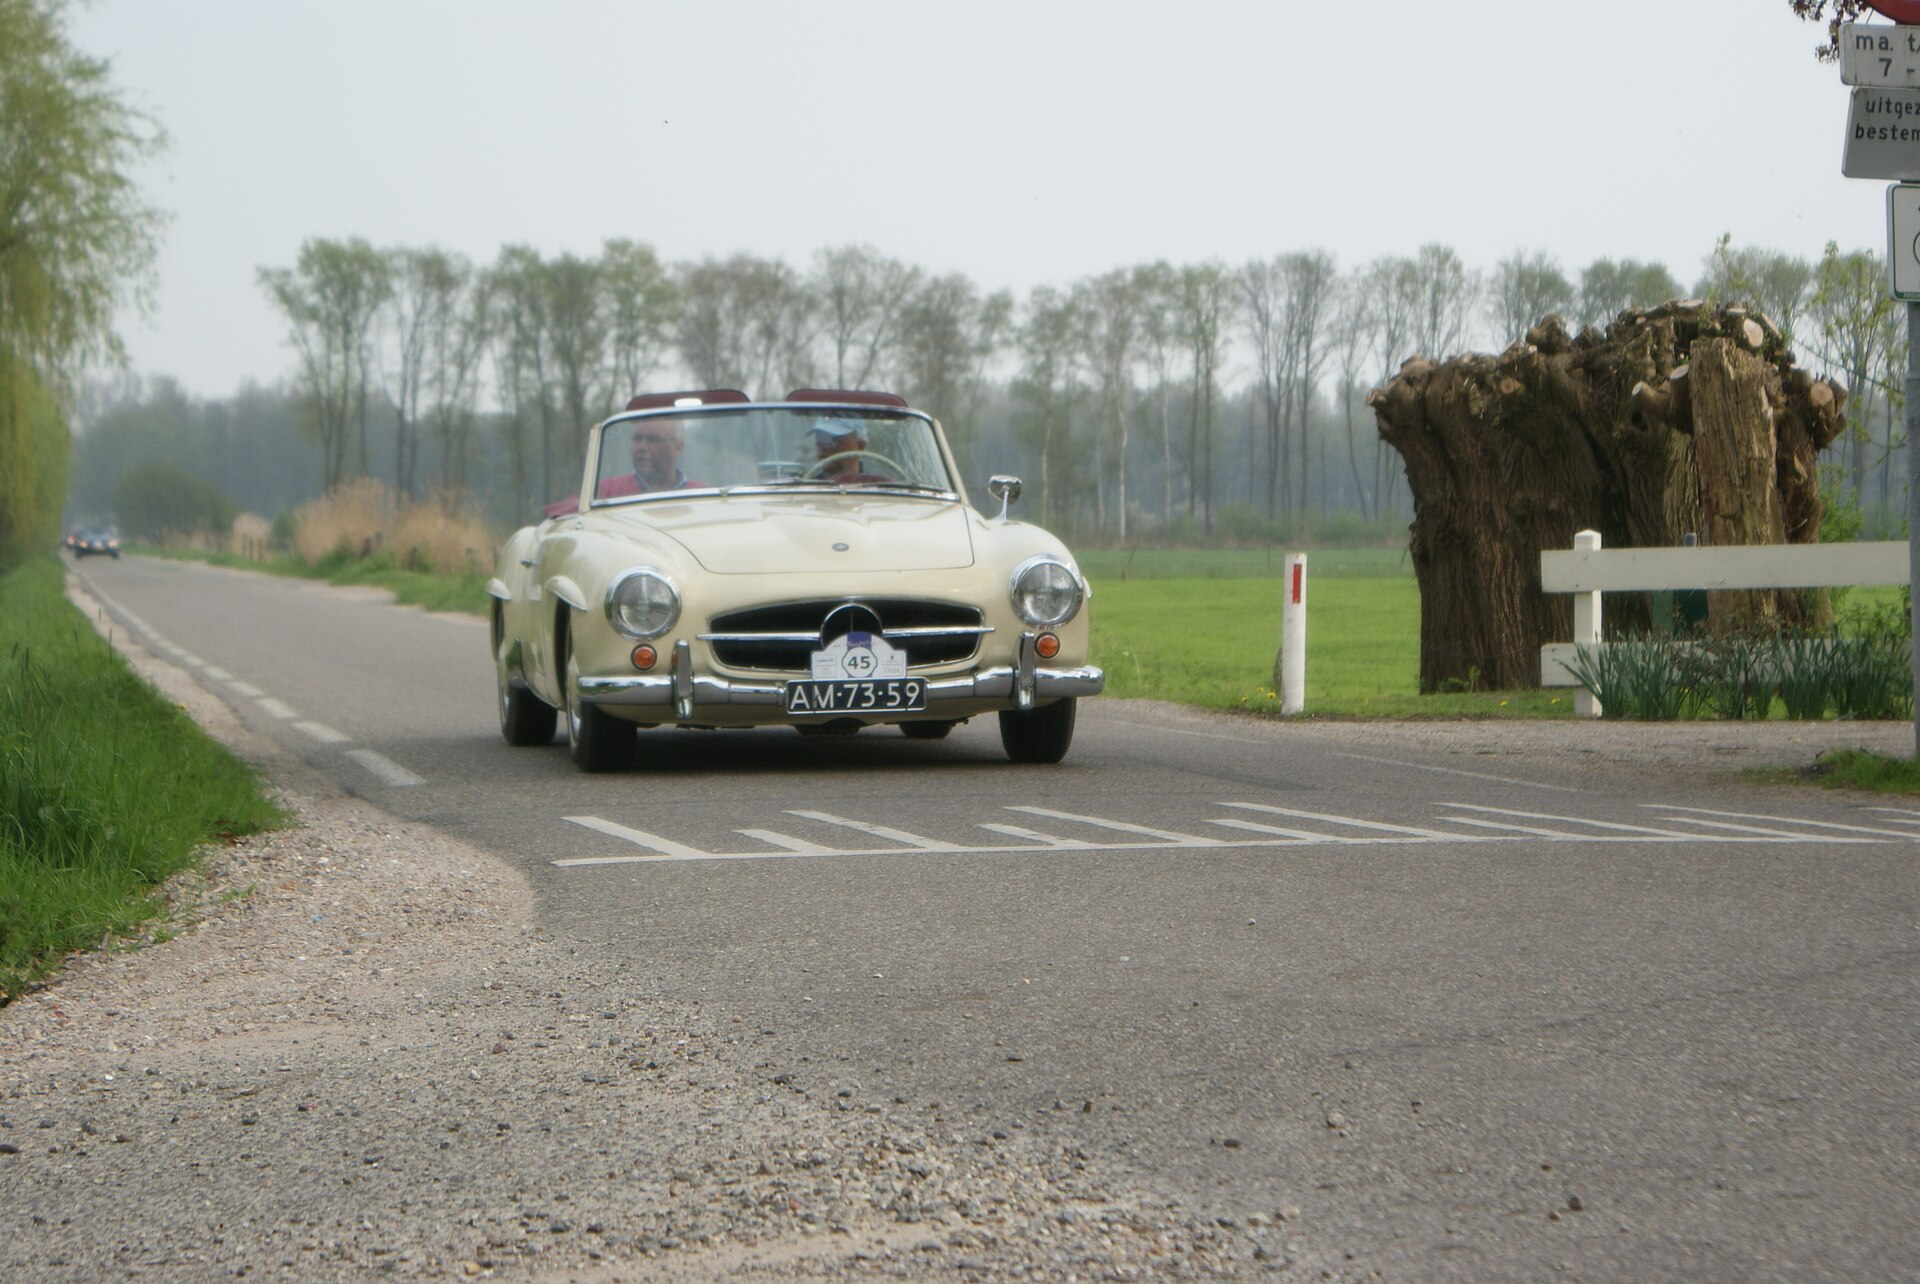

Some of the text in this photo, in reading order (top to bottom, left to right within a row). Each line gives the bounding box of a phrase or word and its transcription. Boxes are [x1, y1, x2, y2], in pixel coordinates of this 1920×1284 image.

[1855, 35, 1893, 51] ma.
[1879, 58, 1892, 77] 7
[847, 656, 870, 670] 45
[789, 682, 920, 710] AM-73-59
